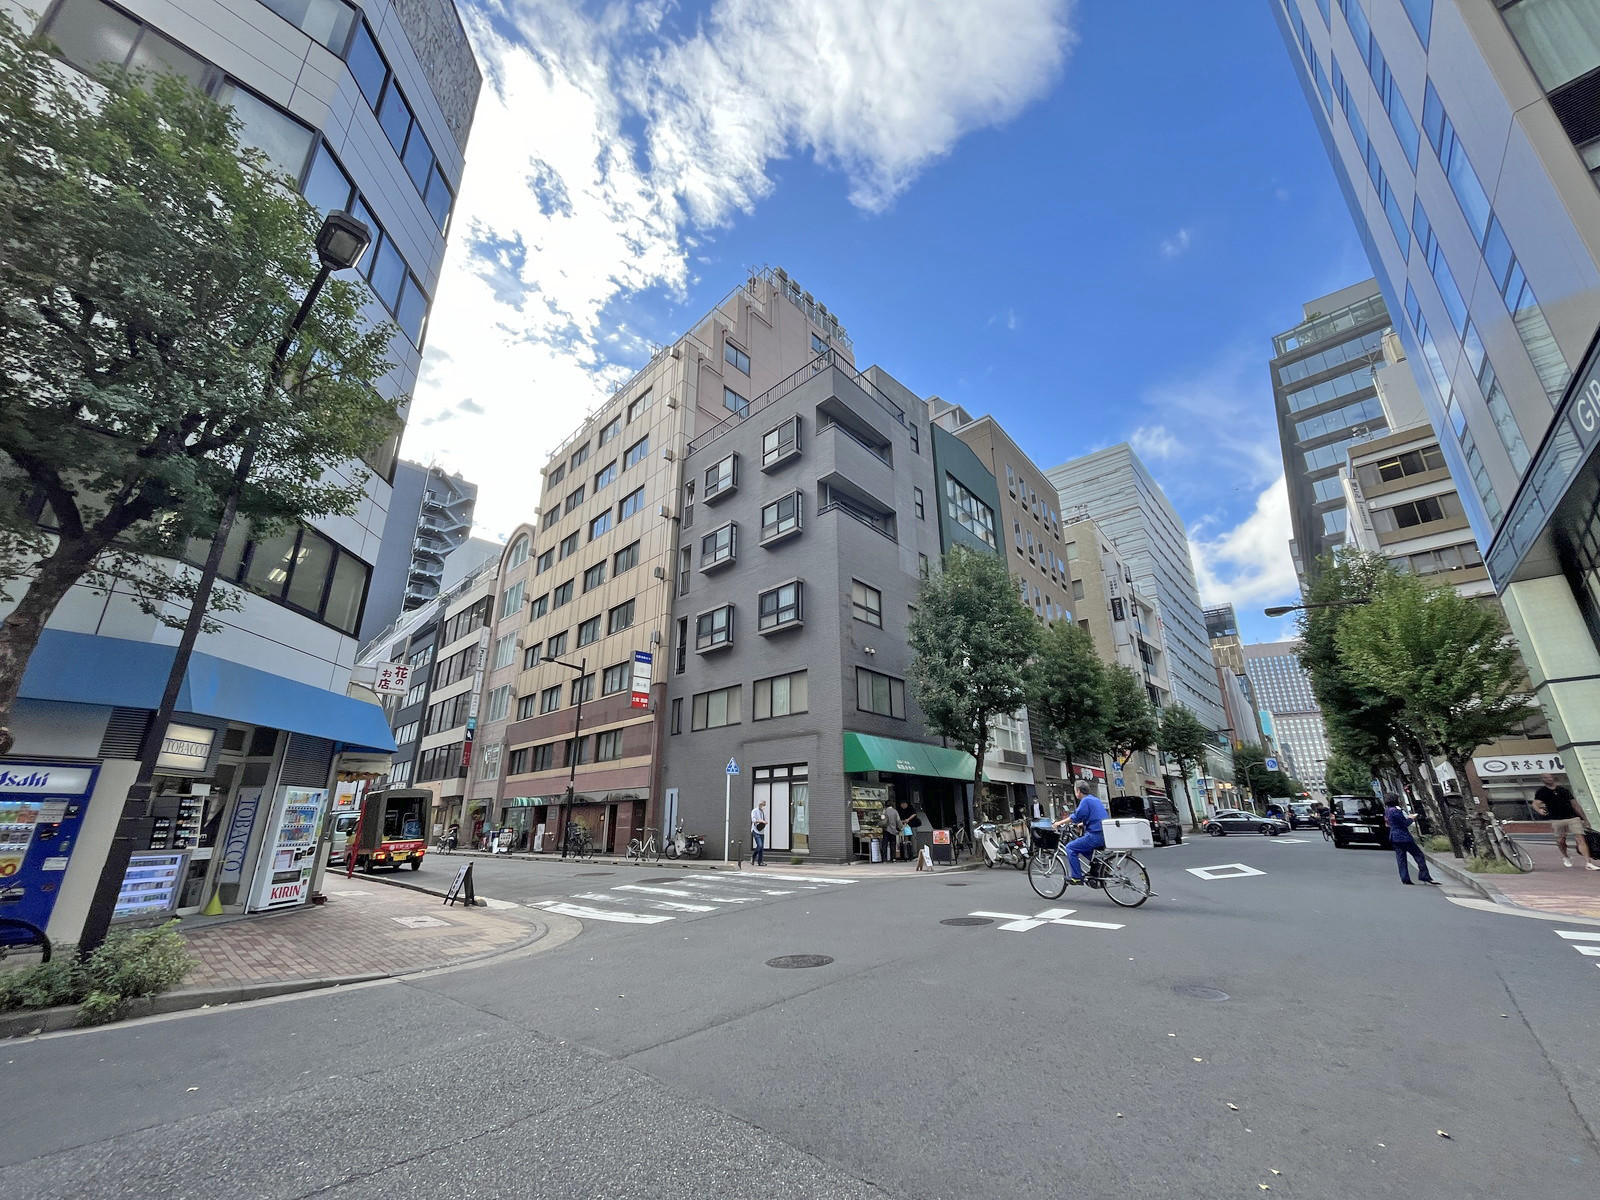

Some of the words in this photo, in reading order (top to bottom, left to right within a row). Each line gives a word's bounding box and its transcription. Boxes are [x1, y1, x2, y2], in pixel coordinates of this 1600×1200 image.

[378, 669, 392, 690] お店
[395, 666, 408, 686] 花の
[164, 740, 209, 756] TOBACCO
[224, 797, 257, 872] TOBACCO
[270, 885, 301, 900] KIRIN
